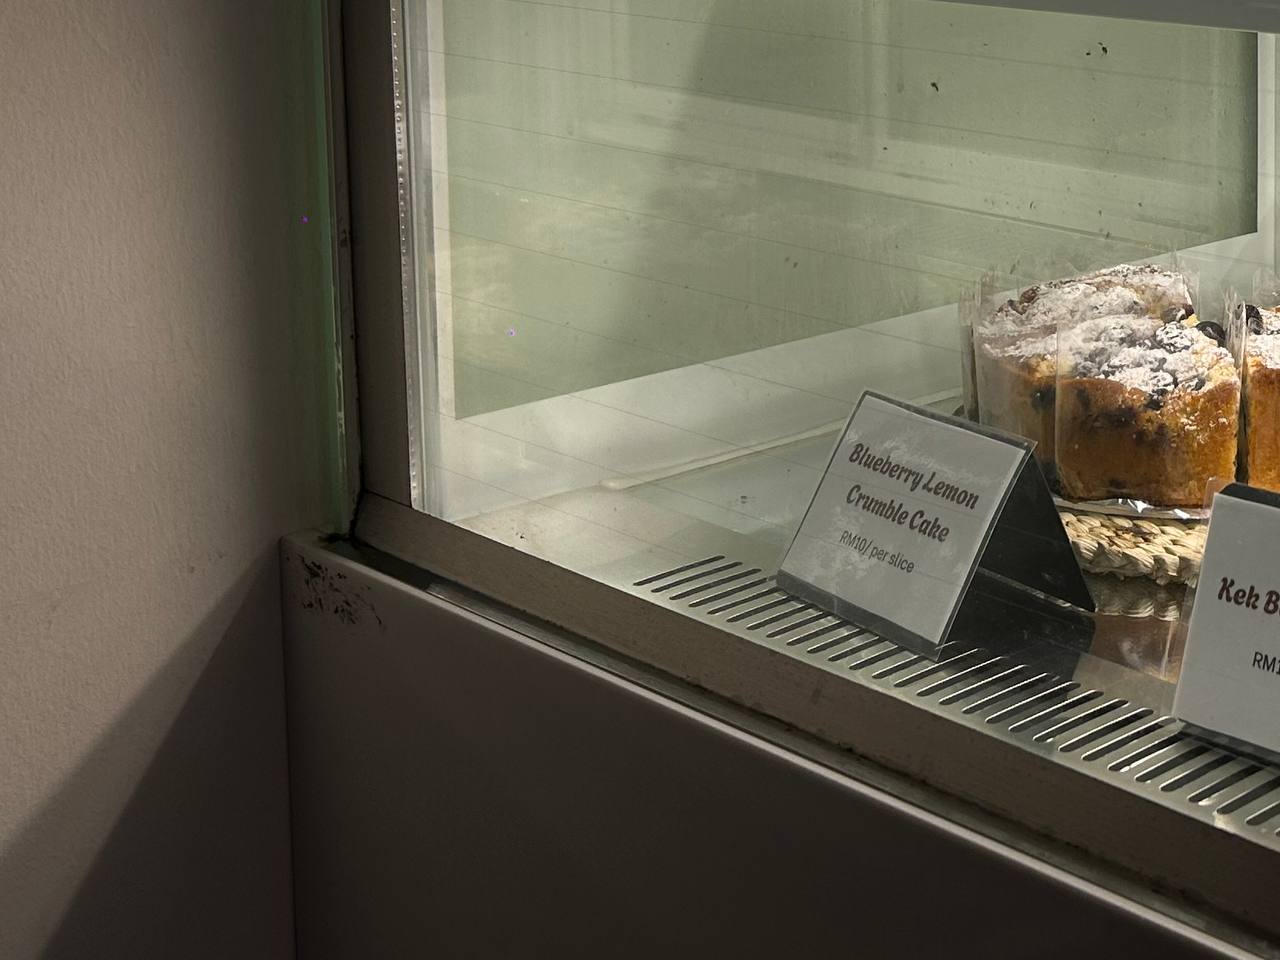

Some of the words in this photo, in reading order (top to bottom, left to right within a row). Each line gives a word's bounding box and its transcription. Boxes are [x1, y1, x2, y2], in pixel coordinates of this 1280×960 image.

[849, 442, 924, 493] Blueberry
[922, 472, 980, 510] Lemon
[846, 484, 909, 526] Crumble
[909, 510, 950, 542] Cake
[868, 546, 889, 561] per
[887, 551, 915, 573] slice
[1217, 577, 1259, 610] Kek
